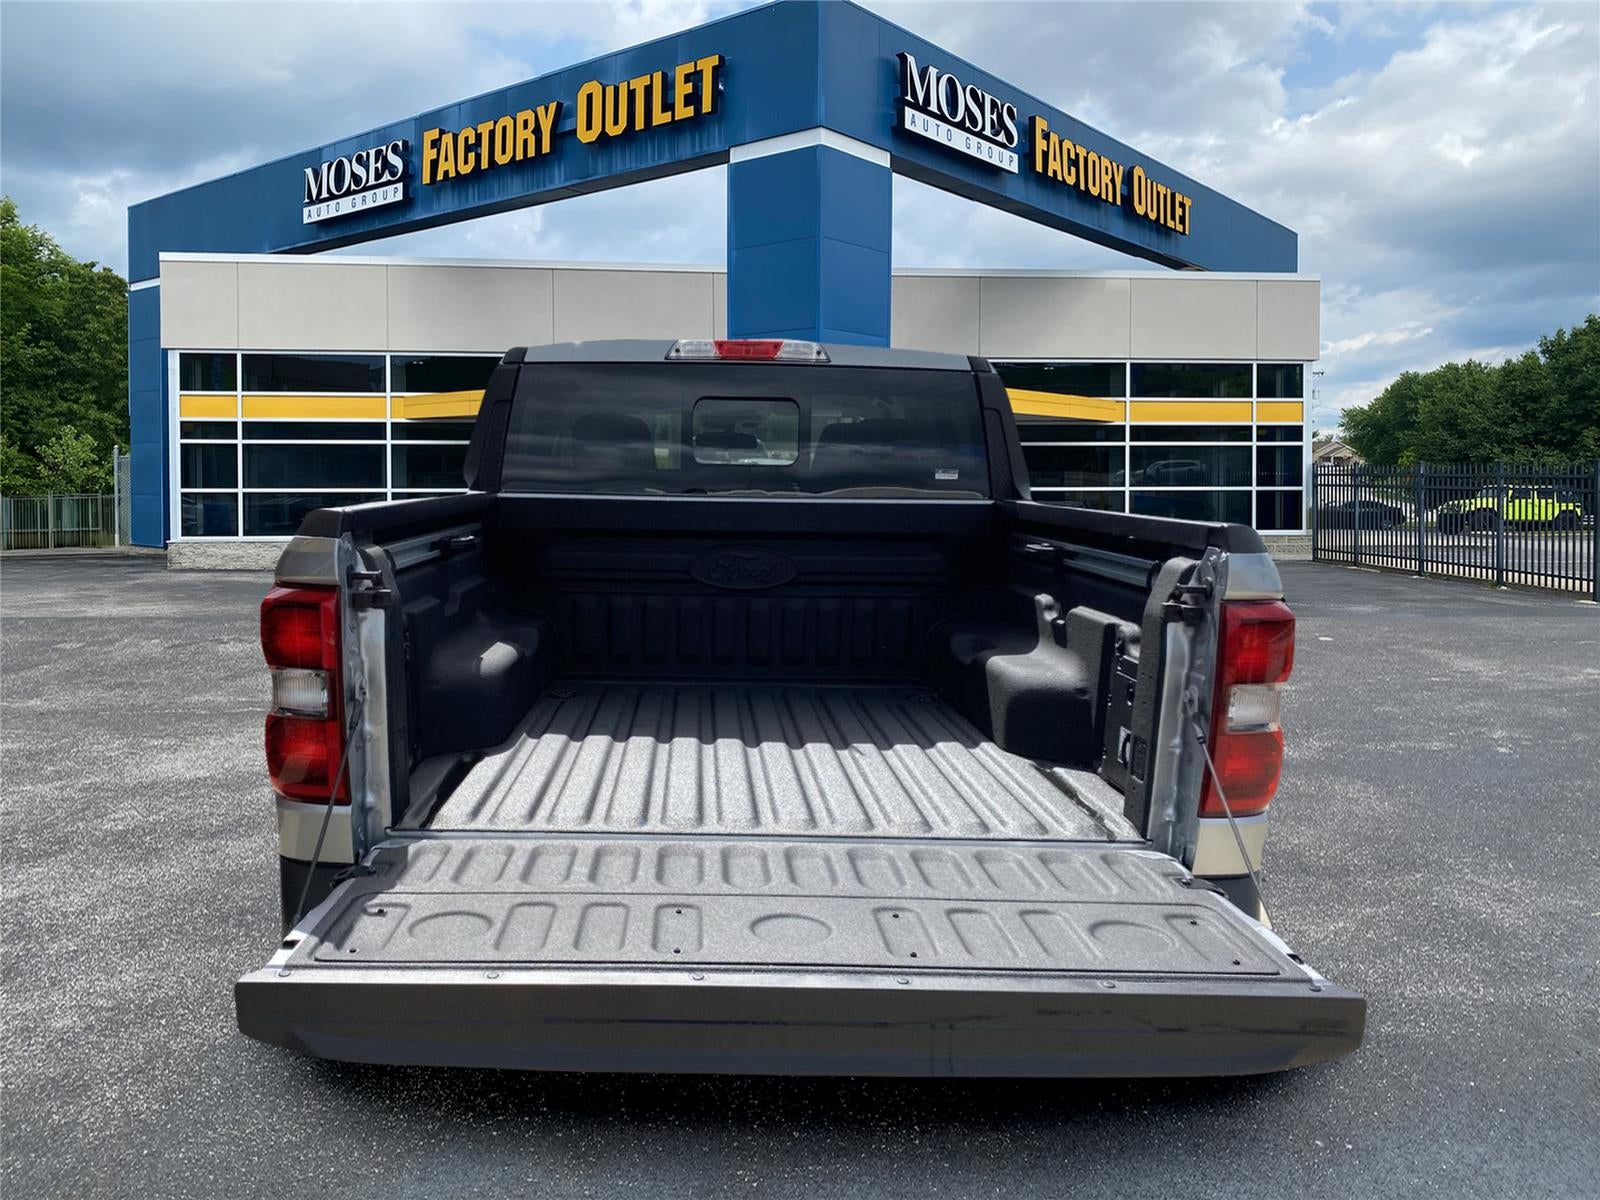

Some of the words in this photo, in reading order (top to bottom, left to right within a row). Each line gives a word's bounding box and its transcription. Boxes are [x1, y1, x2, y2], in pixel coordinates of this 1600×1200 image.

[903, 52, 1018, 148] MOSES
[909, 117, 953, 142] AUTO
[964, 135, 1015, 166] GROUP
[303, 139, 404, 203] MOSES
[307, 203, 341, 221] AUTO
[350, 186, 400, 209] GROUP
